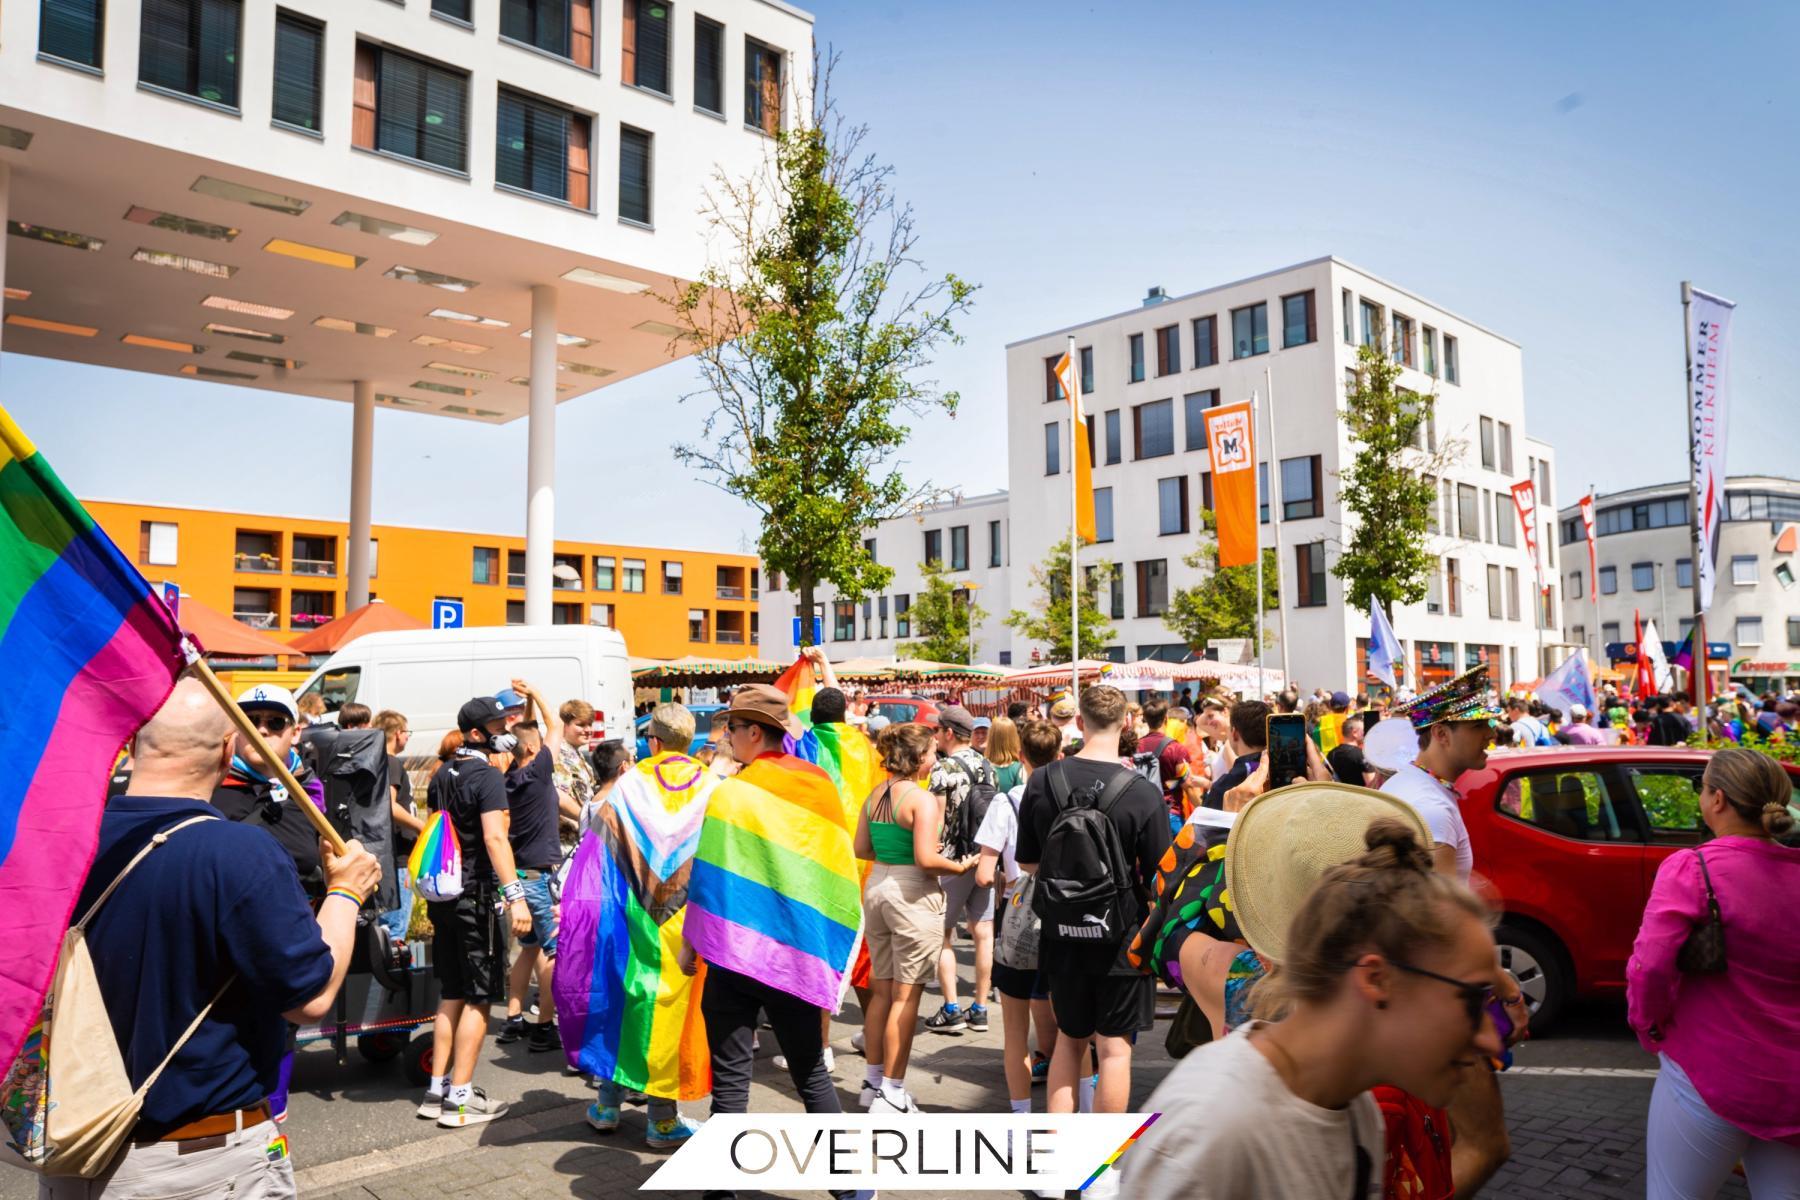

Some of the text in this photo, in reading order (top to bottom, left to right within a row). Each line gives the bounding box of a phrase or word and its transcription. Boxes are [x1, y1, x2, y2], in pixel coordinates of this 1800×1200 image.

[1703, 322, 1720, 456] KELKHEIM
[440, 605, 457, 629] P
[1058, 924, 1103, 938] PUMA
